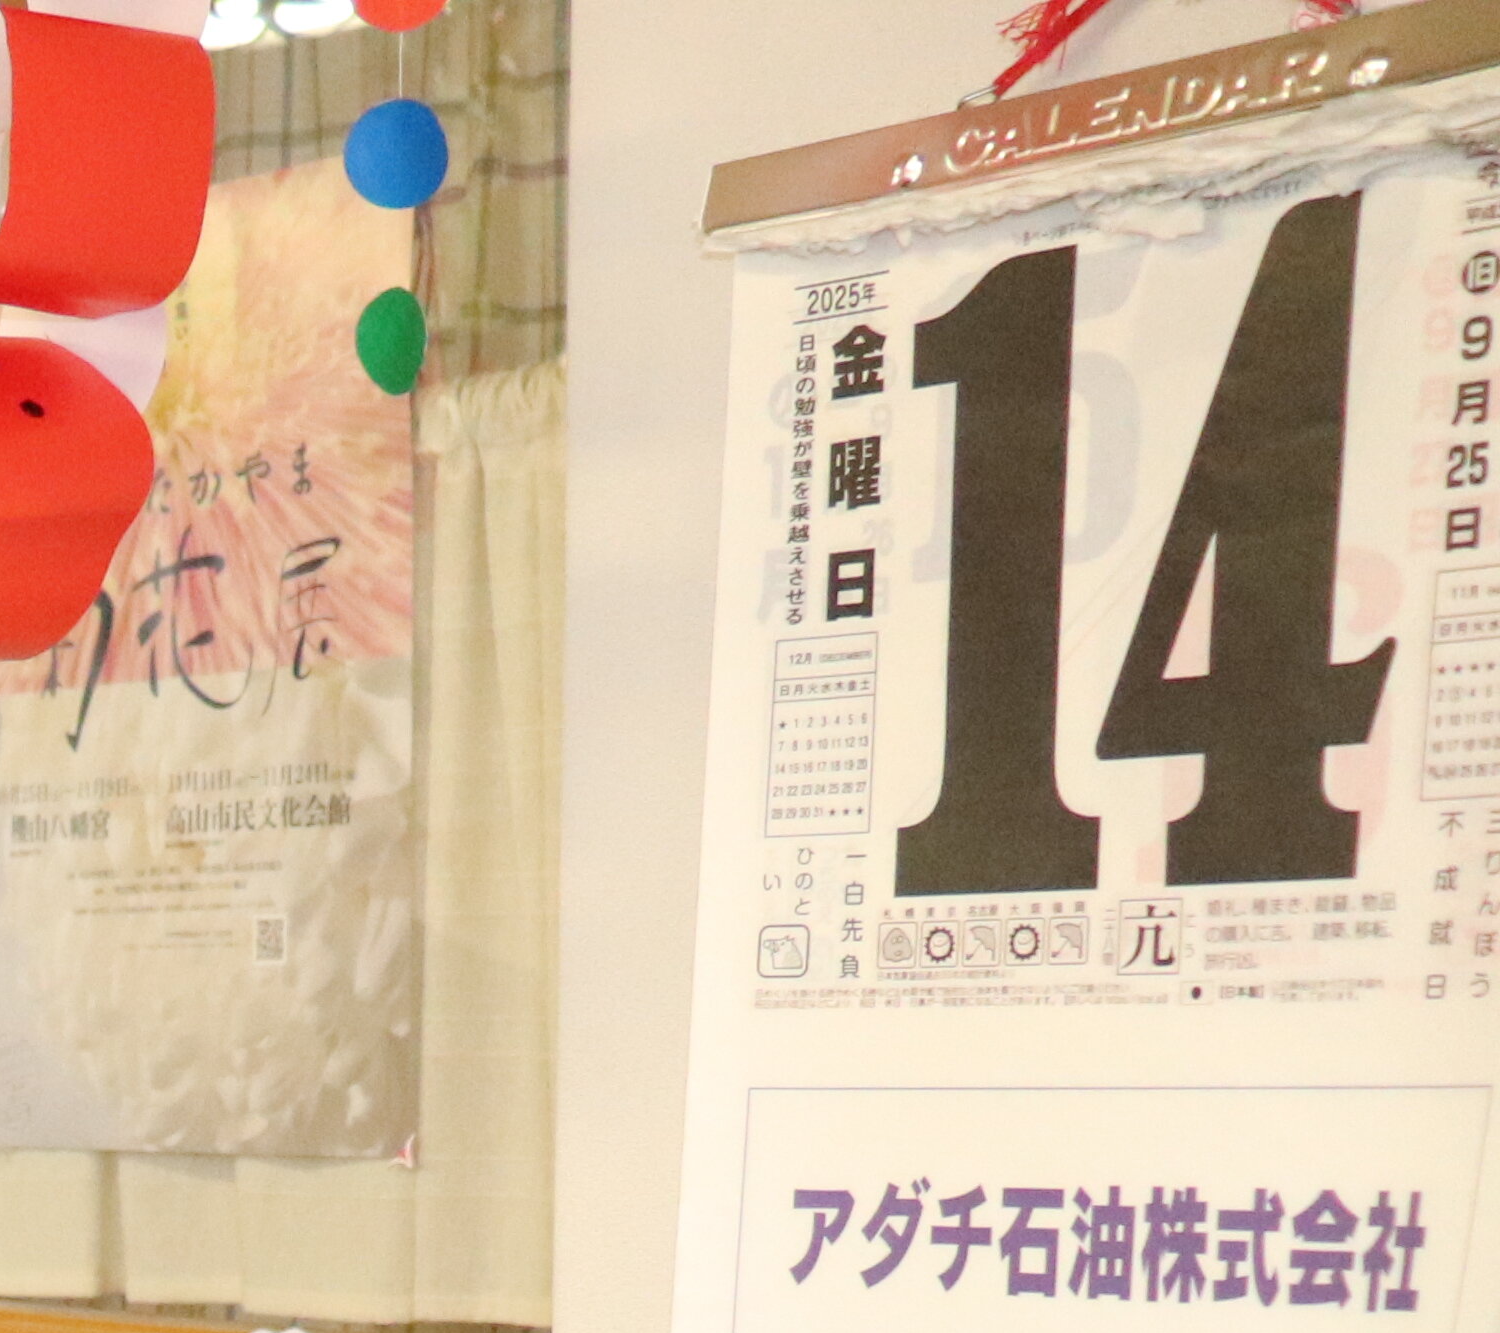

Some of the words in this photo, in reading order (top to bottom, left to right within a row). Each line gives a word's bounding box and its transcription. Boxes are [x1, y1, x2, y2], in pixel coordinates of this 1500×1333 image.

[944, 50, 1330, 174] CALENDAR
[806, 282, 877, 316] 2025年
[784, 333, 816, 626] 日頃の勉強が壁を乗越えさせる
[826, 323, 887, 622] 金曜日
[895, 188, 1399, 898] 14
[789, 653, 812, 664] 12月
[165, 793, 352, 836] 高山市民文化会館
[763, 873, 781, 892] い
[794, 847, 815, 916] ひのと
[840, 852, 868, 979] 一白先負
[1425, 811, 1466, 1000] 不成就日
[787, 1177, 1428, 1313] アダチ石油株式会社
